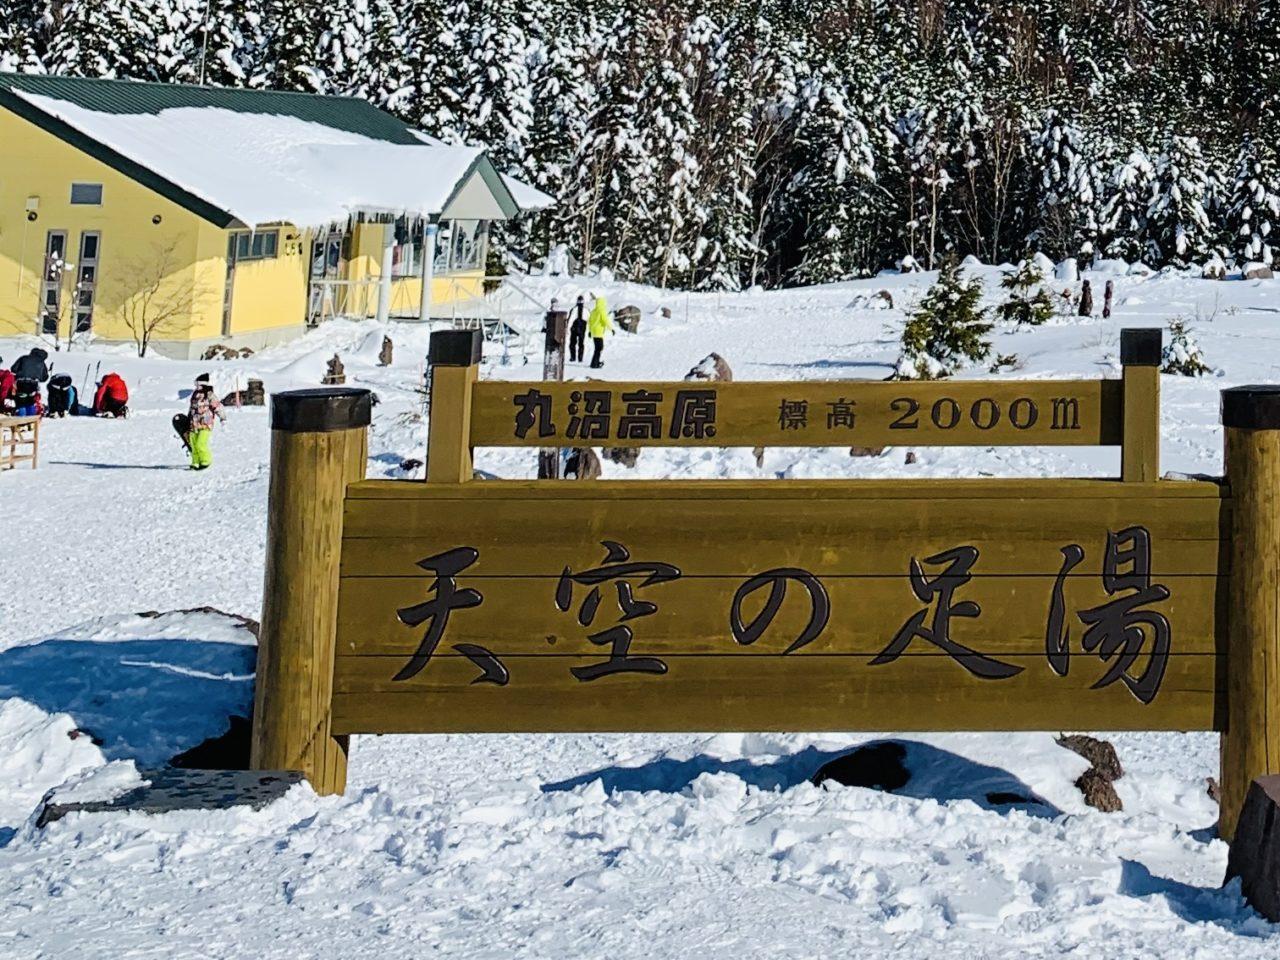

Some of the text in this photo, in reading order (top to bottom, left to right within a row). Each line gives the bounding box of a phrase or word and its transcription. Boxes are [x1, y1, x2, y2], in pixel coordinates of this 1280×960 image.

[513, 388, 1081, 440] 丸沼高原 標高 2000m
[392, 525, 1172, 706] 天空の足湯
